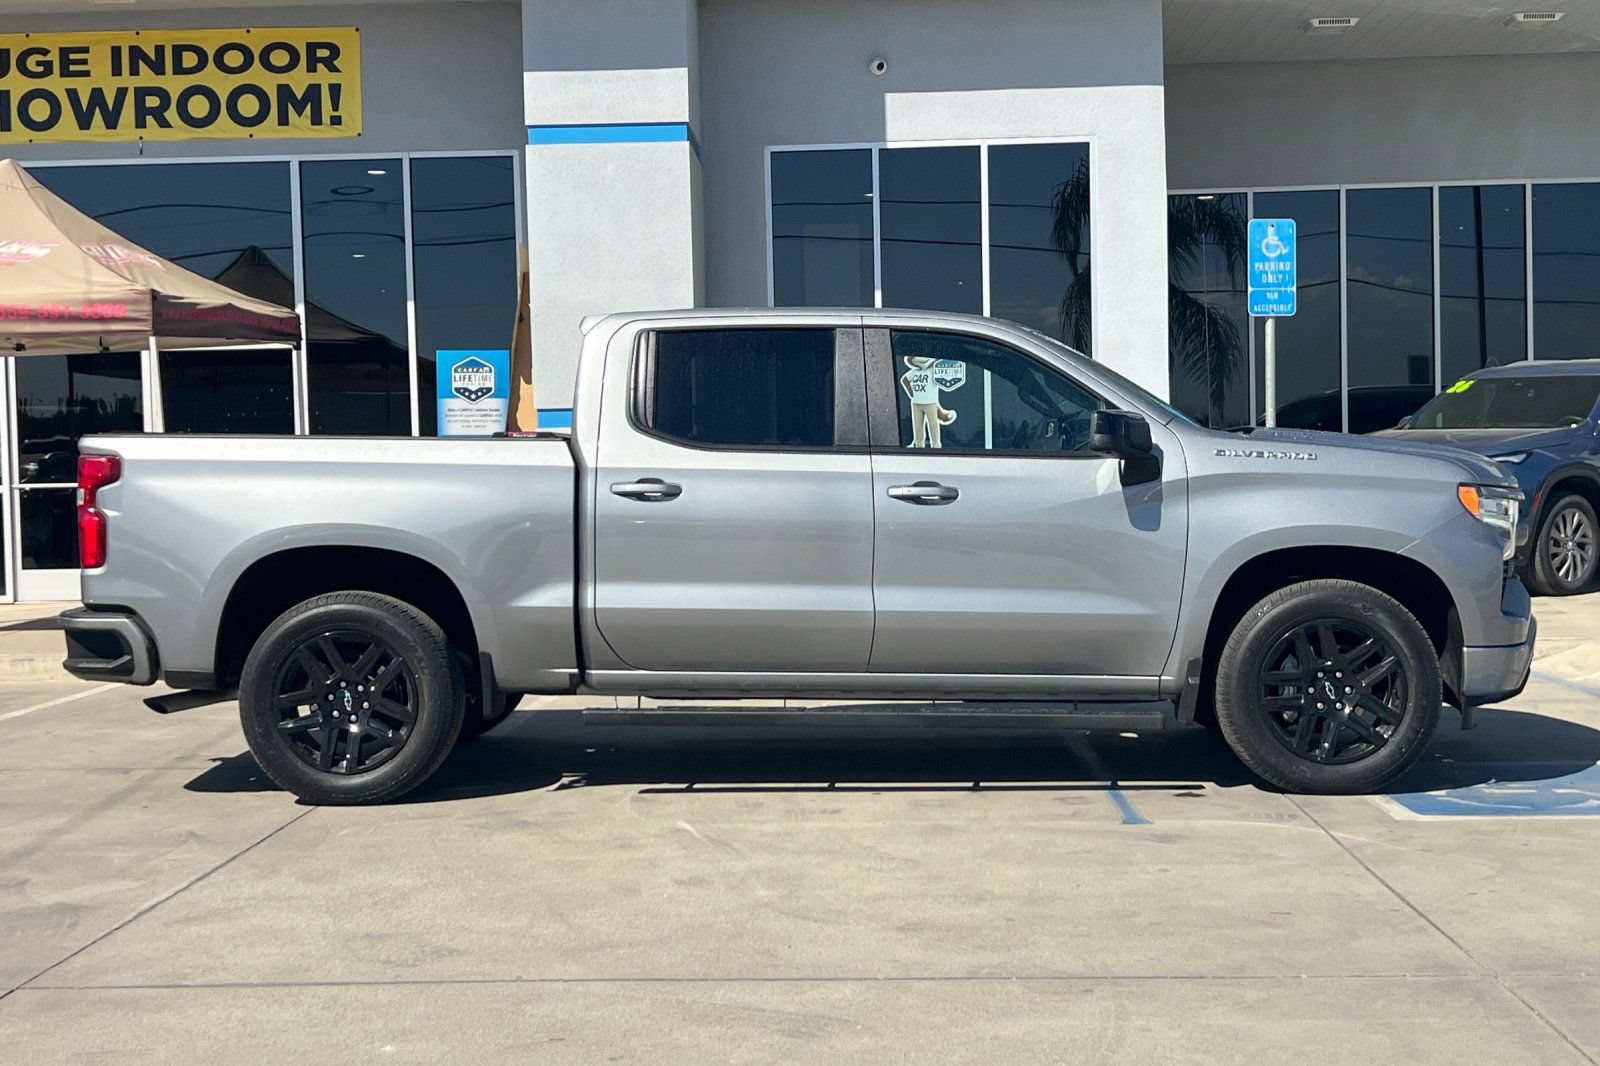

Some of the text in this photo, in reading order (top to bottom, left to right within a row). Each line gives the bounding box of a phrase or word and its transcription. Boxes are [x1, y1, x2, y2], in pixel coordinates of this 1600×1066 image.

[111, 41, 342, 77] INDOOR
[1254, 261, 1291, 272] PARKING
[1261, 273, 1283, 284] ONLY
[1265, 292, 1279, 300] VAN
[1253, 304, 1291, 312] ACCESSIBLE
[913, 375, 928, 383] CAR
[1213, 448, 1318, 460] SILVERADO
